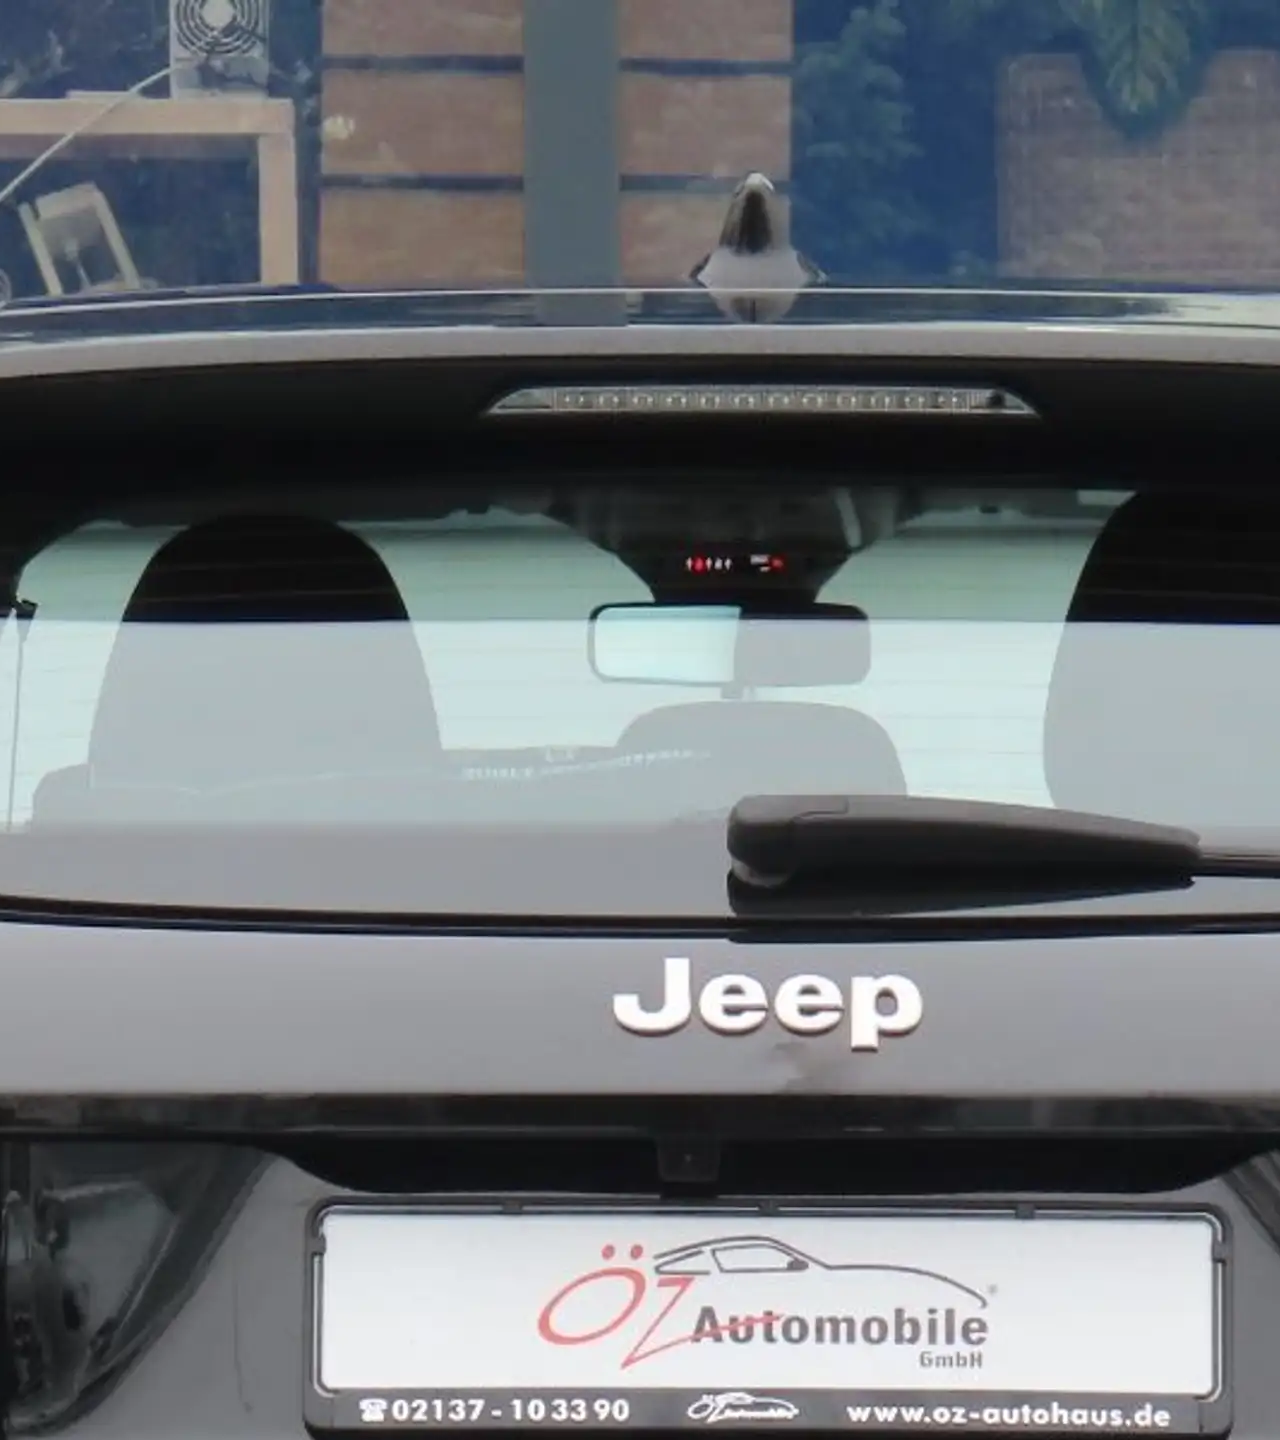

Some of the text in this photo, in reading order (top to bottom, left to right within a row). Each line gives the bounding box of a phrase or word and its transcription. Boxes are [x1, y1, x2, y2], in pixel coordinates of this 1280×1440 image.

[613, 957, 923, 1053] Jeep
[691, 1304, 988, 1346] Automobile
[919, 1351, 983, 1368] GmbH
[846, 1402, 1171, 1427] www.oz-autohaus.de
